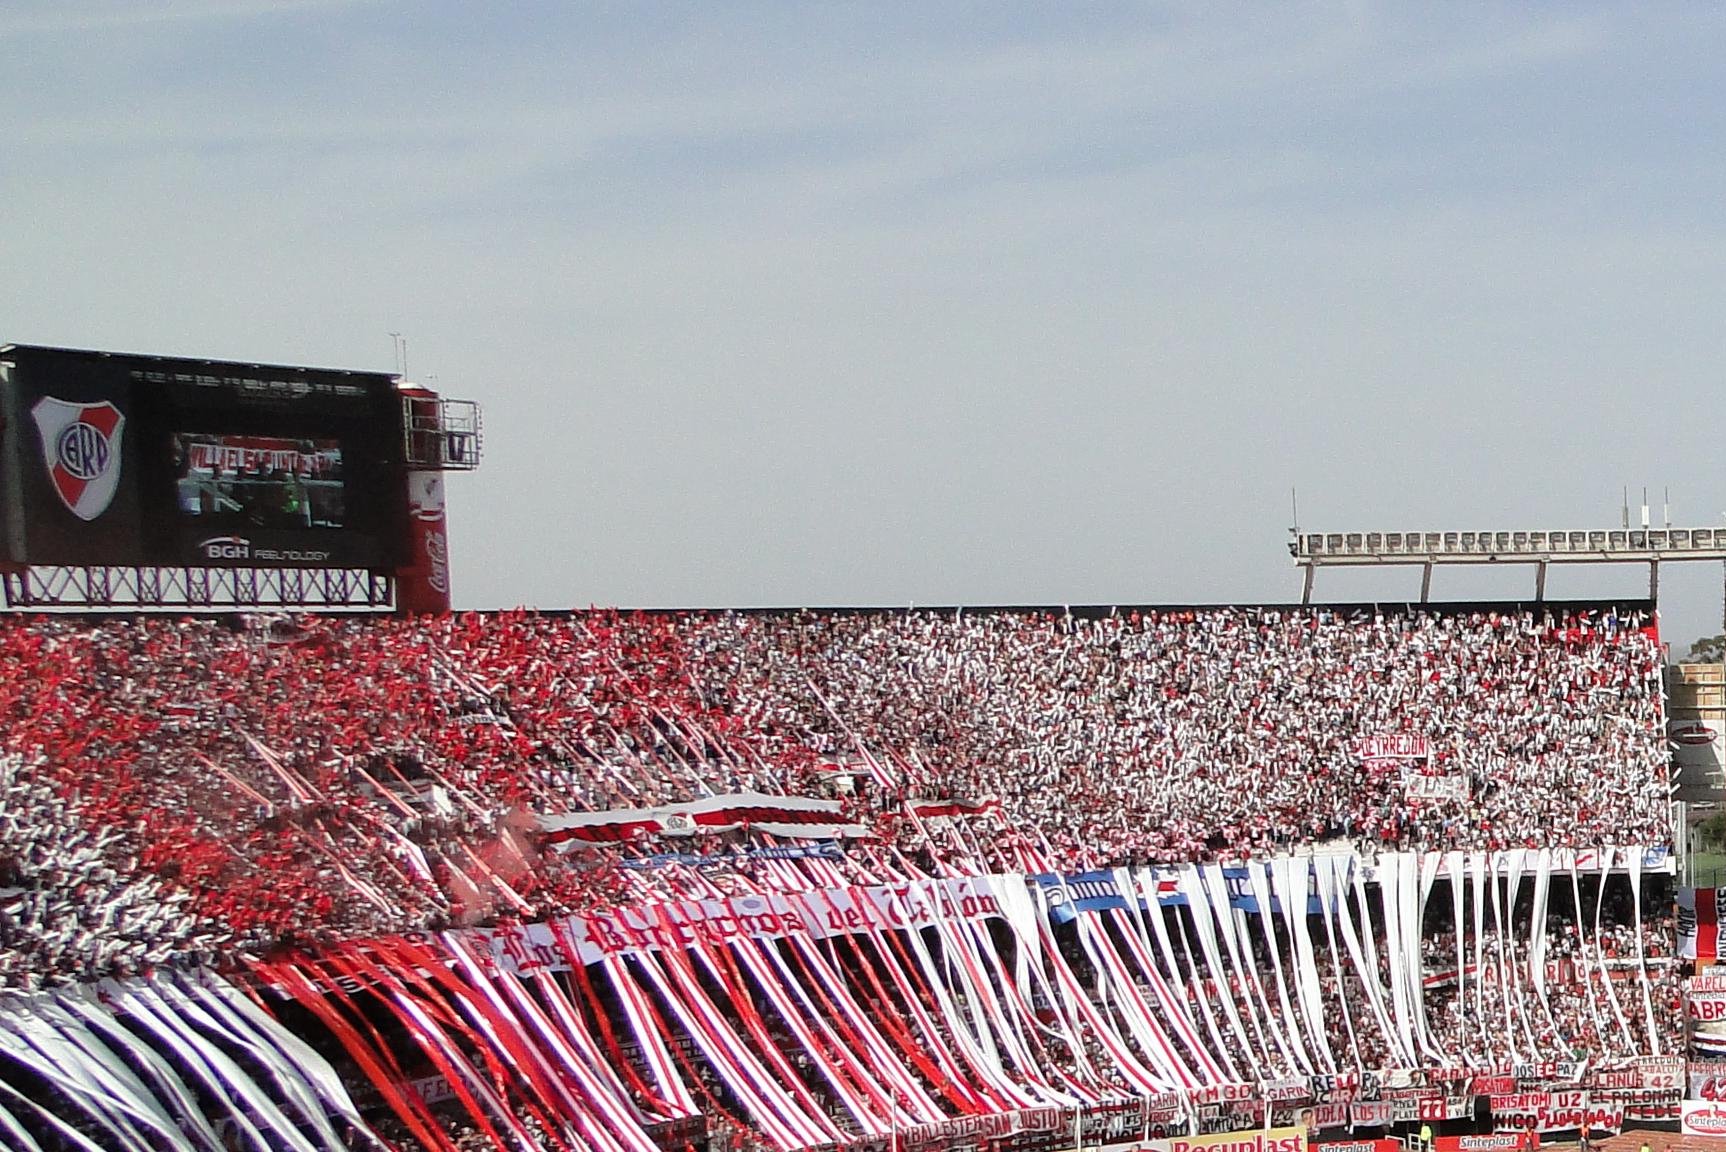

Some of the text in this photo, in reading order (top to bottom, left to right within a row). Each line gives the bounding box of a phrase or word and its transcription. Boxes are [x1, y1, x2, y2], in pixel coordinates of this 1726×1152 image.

[208, 545, 249, 559] BGH
[1557, 1062, 1578, 1076] PAZ
[1268, 1086, 1311, 1101] GARIN
[1421, 1101, 1444, 1118] 77
[984, 1113, 1012, 1137] SAN
[1018, 1110, 1061, 1130] JUSTO
[1460, 1136, 1518, 1150] Sinteplast
